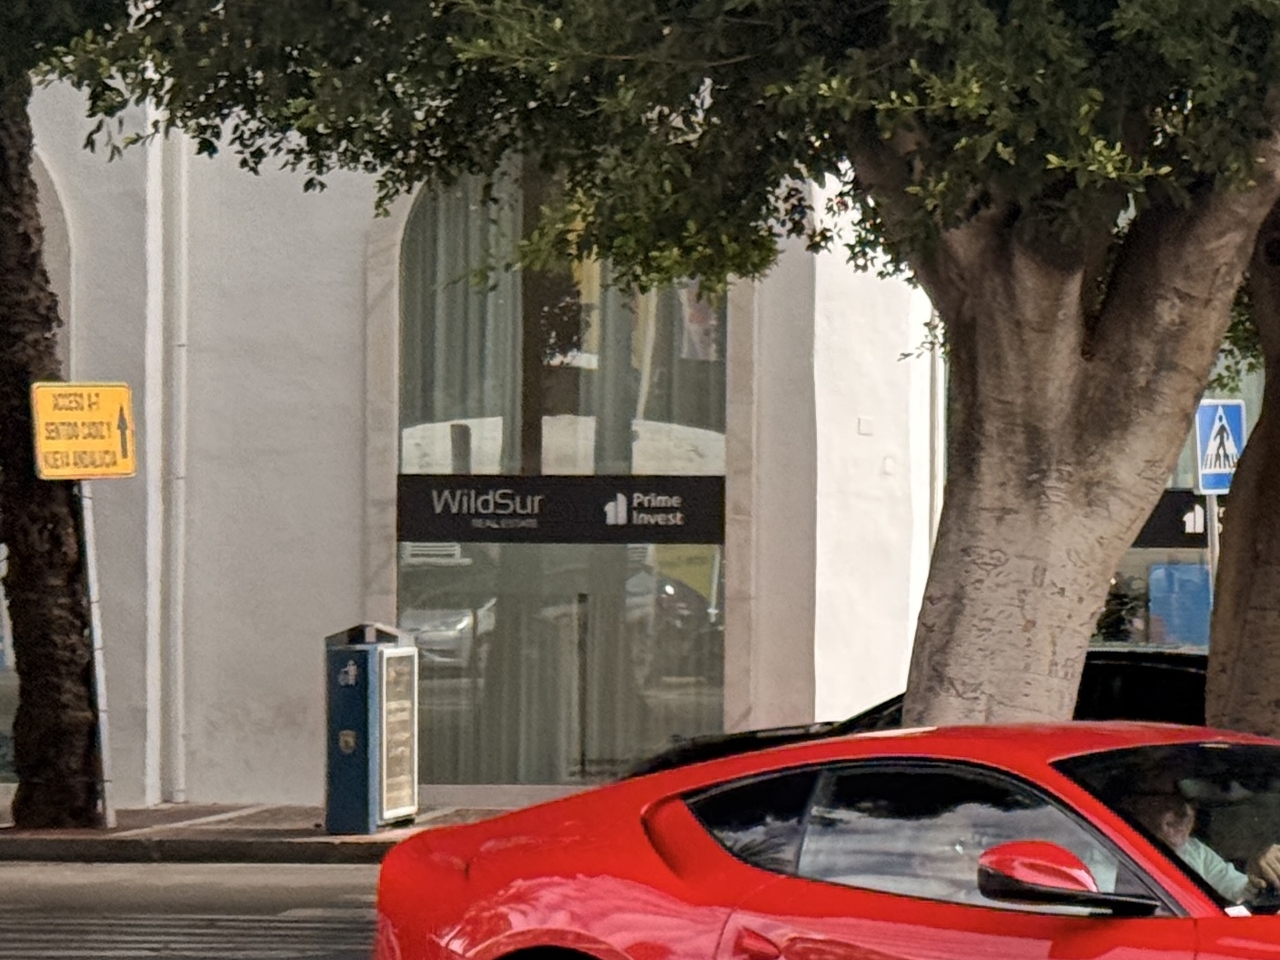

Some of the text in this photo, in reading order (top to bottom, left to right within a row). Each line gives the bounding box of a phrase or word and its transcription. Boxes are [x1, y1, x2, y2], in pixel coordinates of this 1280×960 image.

[432, 489, 544, 514] WildSur
[633, 492, 682, 508] Prime
[633, 510, 684, 525] Invest
